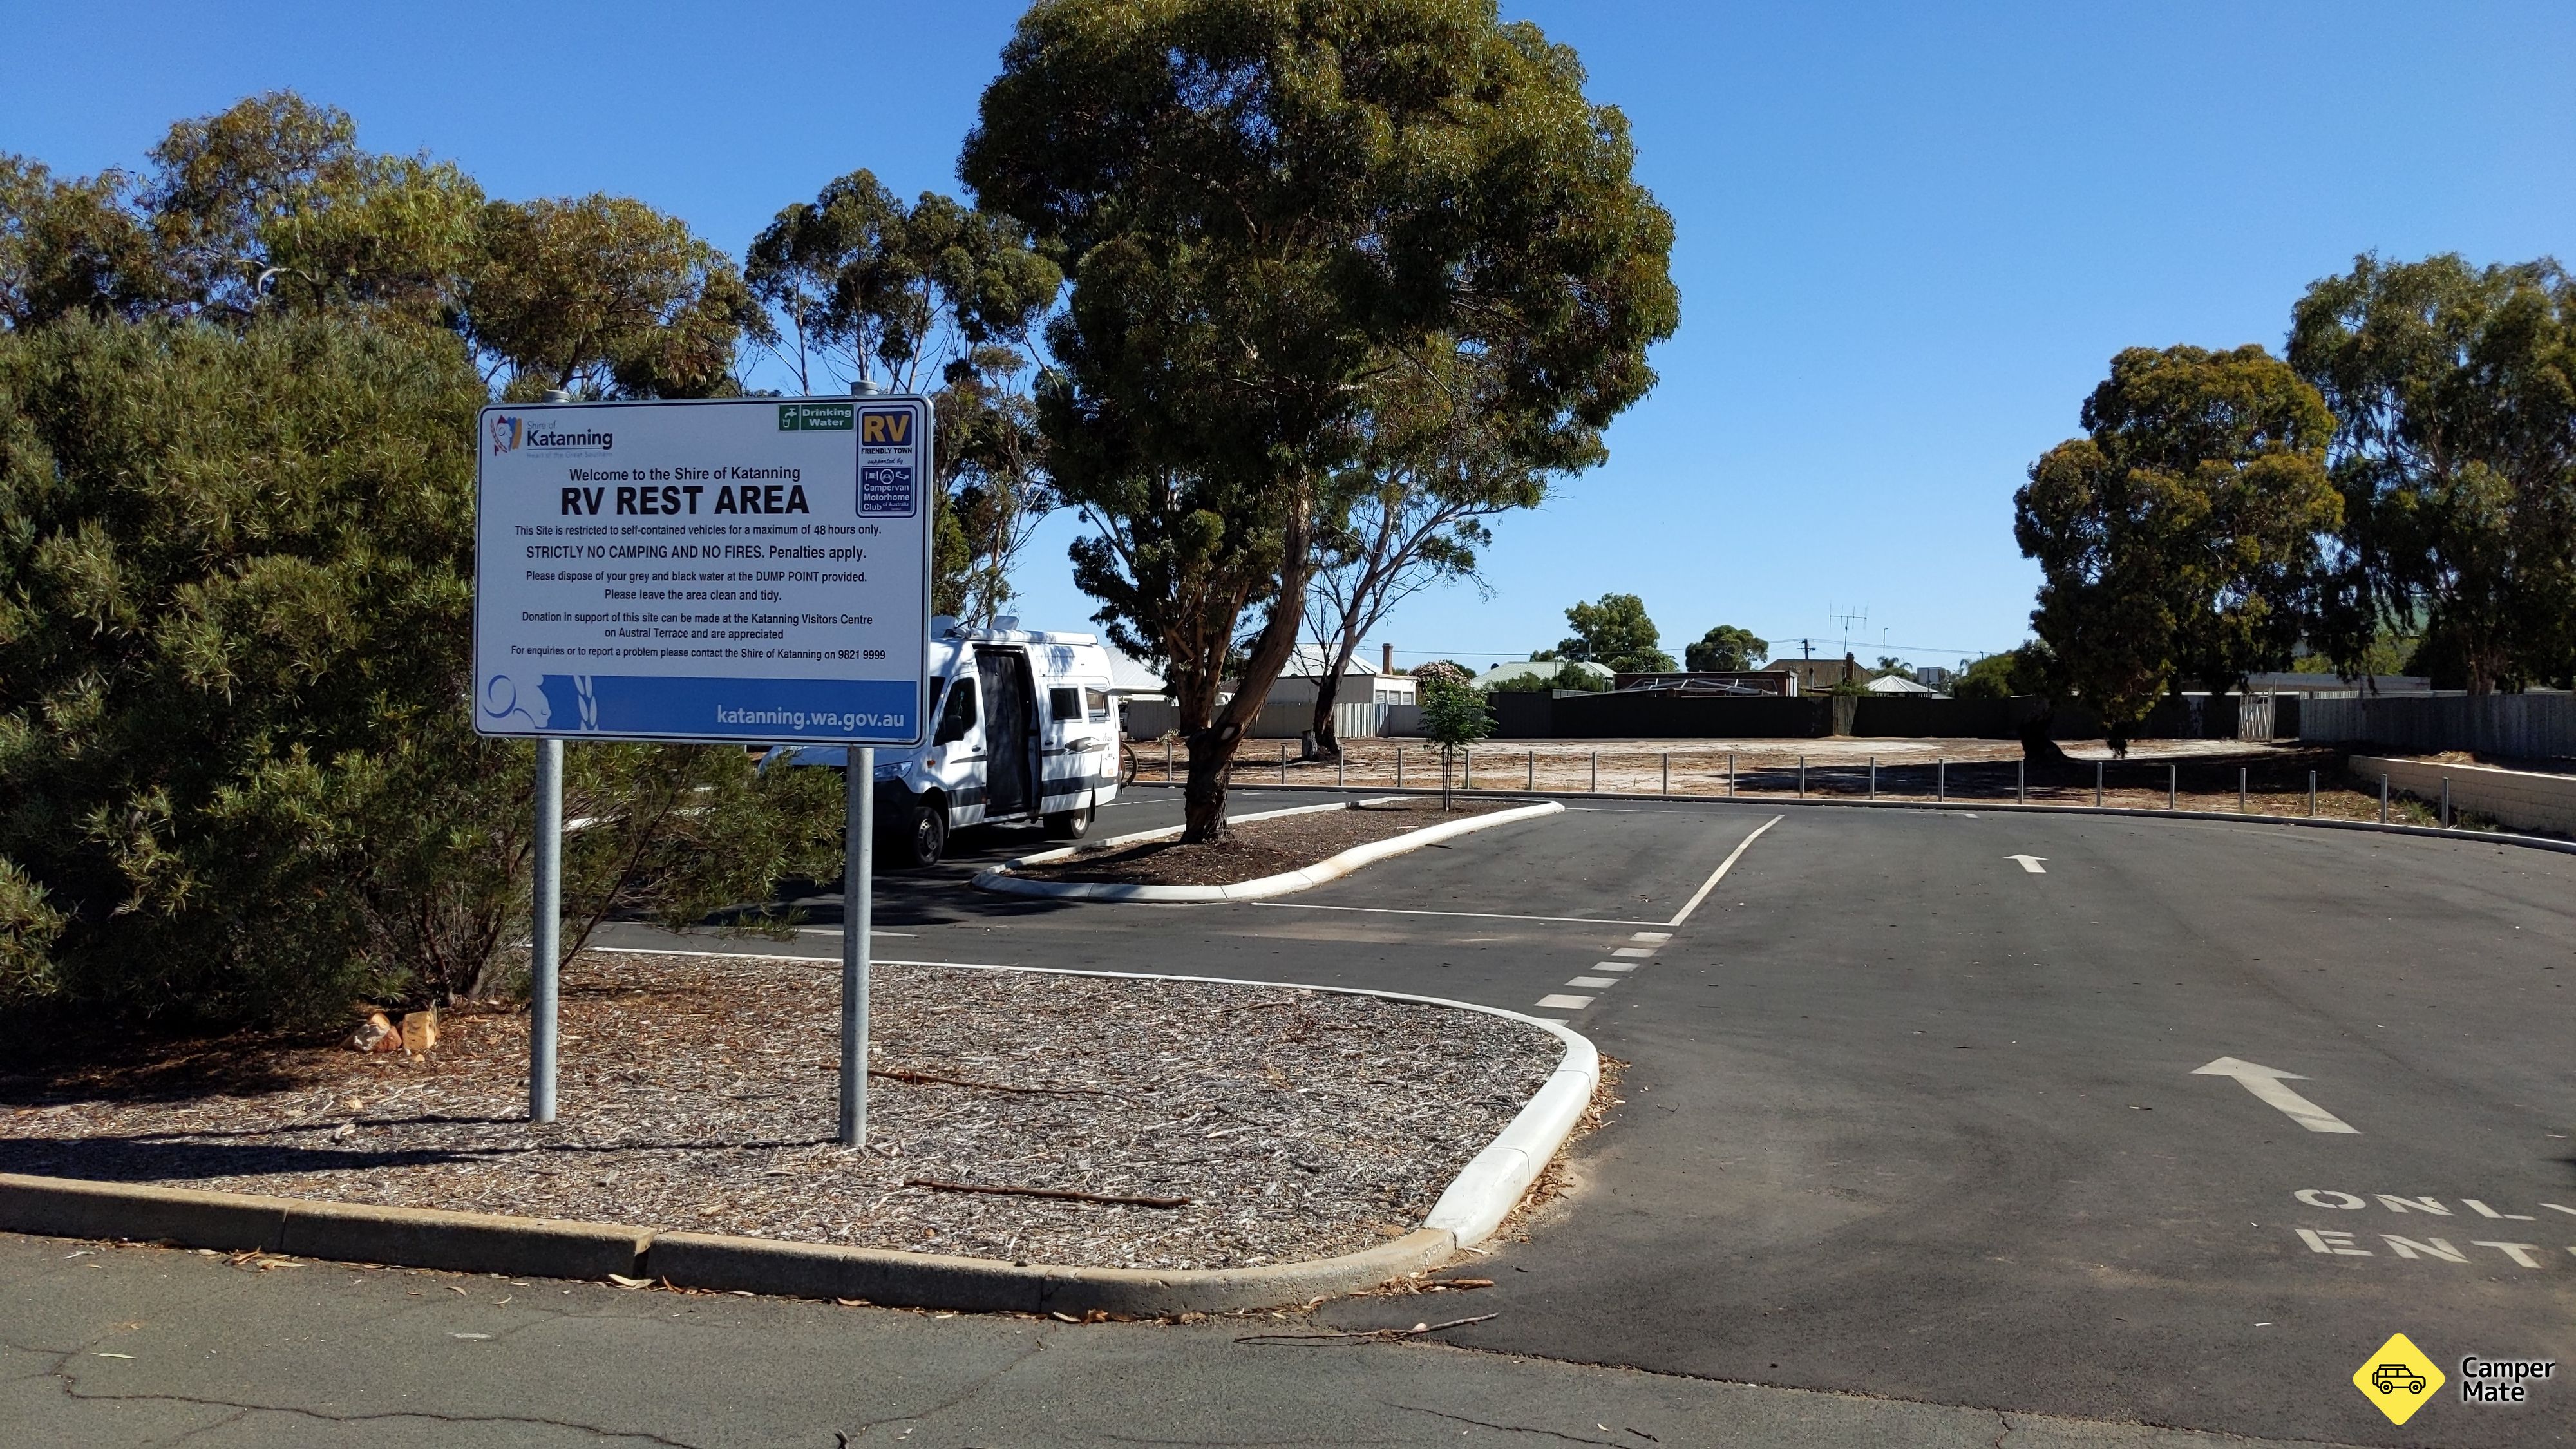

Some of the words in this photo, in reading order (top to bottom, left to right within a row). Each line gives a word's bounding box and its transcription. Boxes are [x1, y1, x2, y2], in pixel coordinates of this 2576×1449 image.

[802, 408, 851, 417] Drinking
[527, 421, 546, 430] Shire
[549, 420, 556, 429] of
[864, 415, 909, 442] RV
[527, 428, 612, 450] Katanning
[570, 469, 629, 482] Welcome
[632, 469, 646, 481] to
[650, 468, 670, 480] the
[675, 467, 710, 480] Shire
[714, 466, 728, 480] of
[732, 466, 800, 483] Katanning
[864, 484, 909, 493] Campervan
[562, 486, 605, 515] RV
[616, 485, 704, 515] REST
[714, 484, 810, 515] AREA
[515, 526, 534, 535] This
[536, 525, 553, 535] Site
[555, 525, 563, 535] is
[565, 525, 607, 535] restricted
[609, 526, 619, 535] to
[621, 525, 686, 535] self-contained
[688, 524, 726, 535] vehicles
[728, 524, 743, 535] for
[744, 526, 750, 535] a
[753, 524, 798, 535] maximum
[800, 524, 811, 535] of
[813, 524, 826, 535] 48
[828, 524, 856, 535] hours
[858, 524, 882, 537] only.
[526, 545, 584, 558] STRICTLY
[587, 545, 605, 558] NO
[609, 545, 668, 558] CAMPING
[671, 545, 698, 558] AND
[702, 545, 721, 558] NO
[724, 545, 765, 558] FIRES.
[769, 545, 826, 558] Penalties
[829, 545, 866, 562] apply.
[526, 571, 556, 581] Please
[558, 571, 593, 583] dispose
[595, 571, 605, 581] of
[607, 573, 627, 583] your
[629, 573, 650, 583] grey
[652, 571, 669, 581] and
[672, 571, 697, 581] black
[699, 571, 725, 582] water
[727, 572, 736, 582] at
[738, 571, 753, 582] the
[756, 571, 785, 582] DUMP
[788, 571, 820, 582] POINT
[822, 571, 867, 584] provided.
[605, 589, 637, 600] Please
[639, 589, 665, 600] leave
[667, 589, 683, 600] the
[686, 591, 707, 600] area
[710, 589, 737, 600] clean
[739, 589, 758, 600] and
[760, 589, 782, 603] tidy.
[522, 611, 562, 621] Donation
[564, 612, 572, 621] in
[574, 612, 609, 624] support
[611, 612, 621, 622] of
[623, 612, 639, 623] this
[642, 612, 659, 623] site
[661, 614, 677, 623] can
[680, 612, 692, 623] be
[694, 613, 720, 623] made
[723, 614, 732, 623] at
[734, 613, 749, 623] the
[752, 613, 799, 627] Katanning
[801, 614, 838, 625] Visitors
[840, 614, 873, 625] Centre
[618, 627, 651, 638] Austral
[653, 627, 688, 638] Terrace
[690, 628, 708, 638] and
[710, 630, 726, 639] are
[728, 629, 784, 641] appreciated
[511, 645, 525, 654] For
[527, 645, 565, 657] enquiries
[578, 647, 586, 656] to
[588, 647, 614, 658] report
[623, 647, 658, 658] problem
[660, 647, 688, 659] please
[691, 649, 723, 658] contact
[724, 648, 739, 658] the
[741, 648, 764, 658] Shire
[766, 649, 775, 658] of
[777, 649, 822, 661] Katanning
[824, 651, 836, 659] on
[838, 649, 860, 659] 9821
[862, 650, 886, 660] 9999
[717, 704, 904, 732] katanning.wa.gov.au
[2295, 1229, 2576, 1269] ENT
